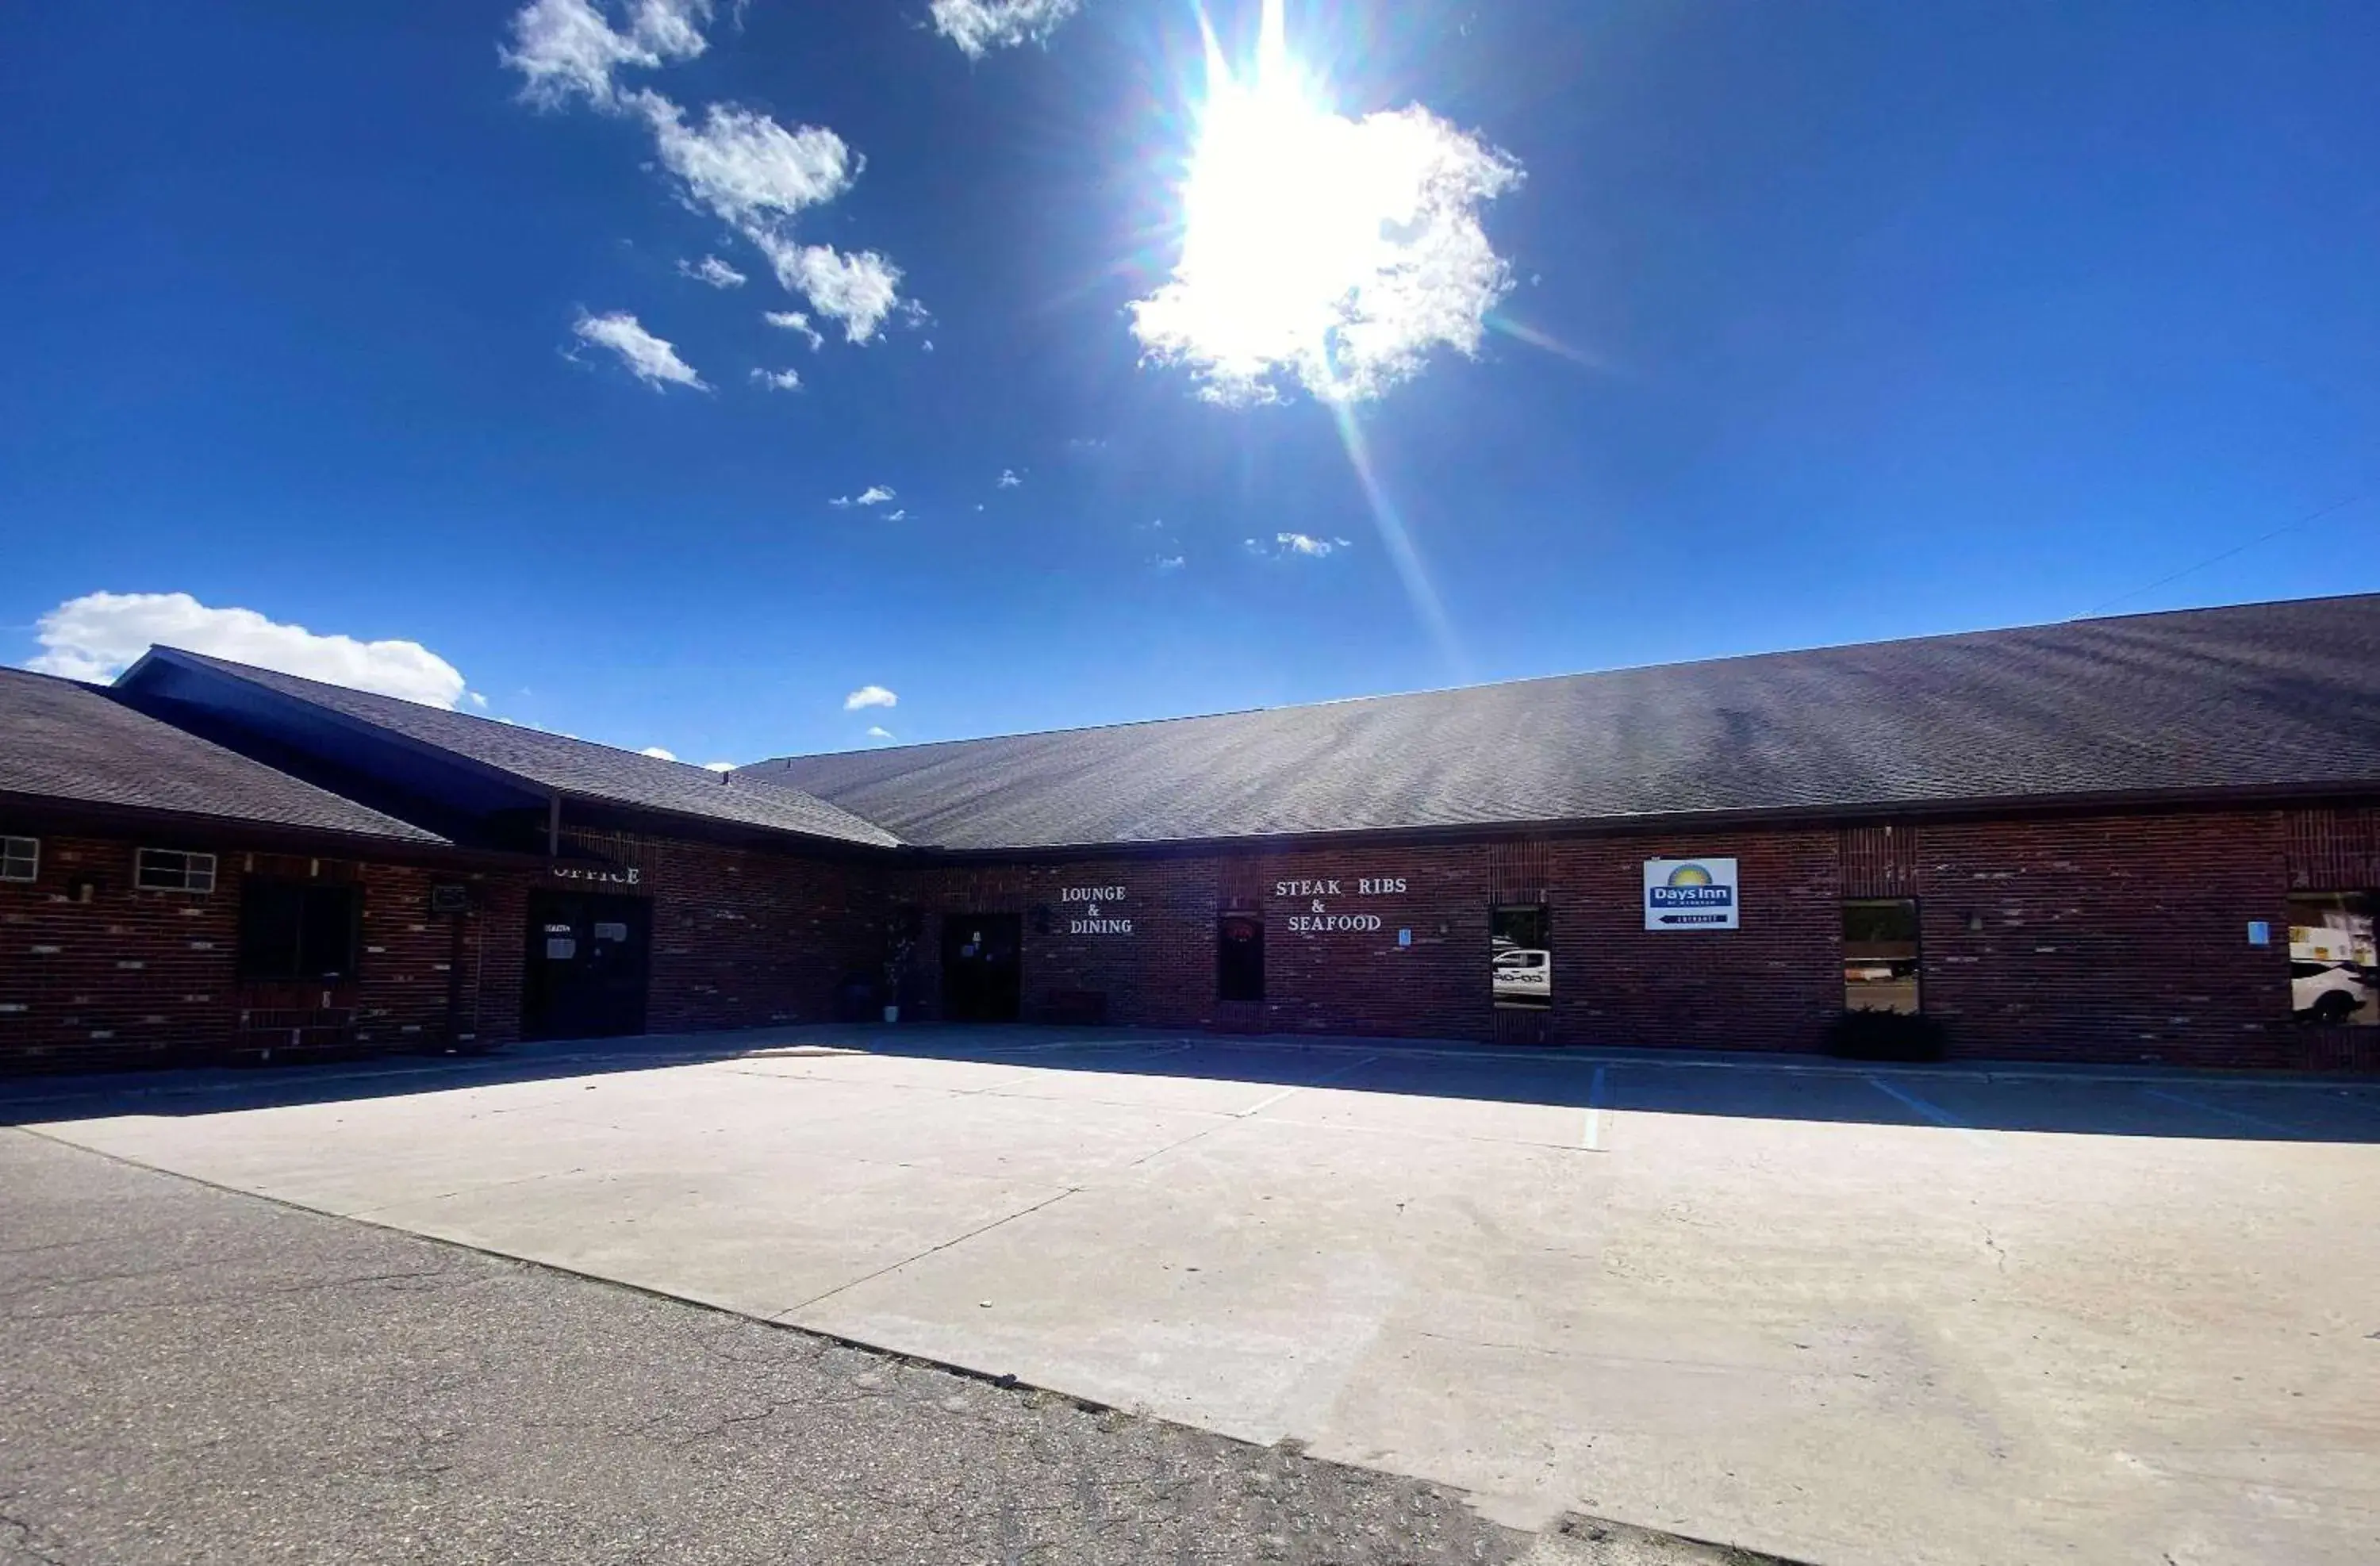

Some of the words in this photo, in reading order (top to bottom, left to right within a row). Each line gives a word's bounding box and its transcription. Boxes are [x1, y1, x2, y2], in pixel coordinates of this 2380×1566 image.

[1061, 886, 1127, 901] LOUNGE
[1276, 880, 1342, 895] STEAK
[1358, 878, 1407, 894] RIBS
[1655, 888, 1695, 900] Days
[1699, 888, 1727, 899] Inn
[1088, 904, 1100, 916] &
[1311, 899, 1326, 913] &
[1071, 919, 1133, 934] DINING
[1288, 915, 1382, 931] SEAFOOD
